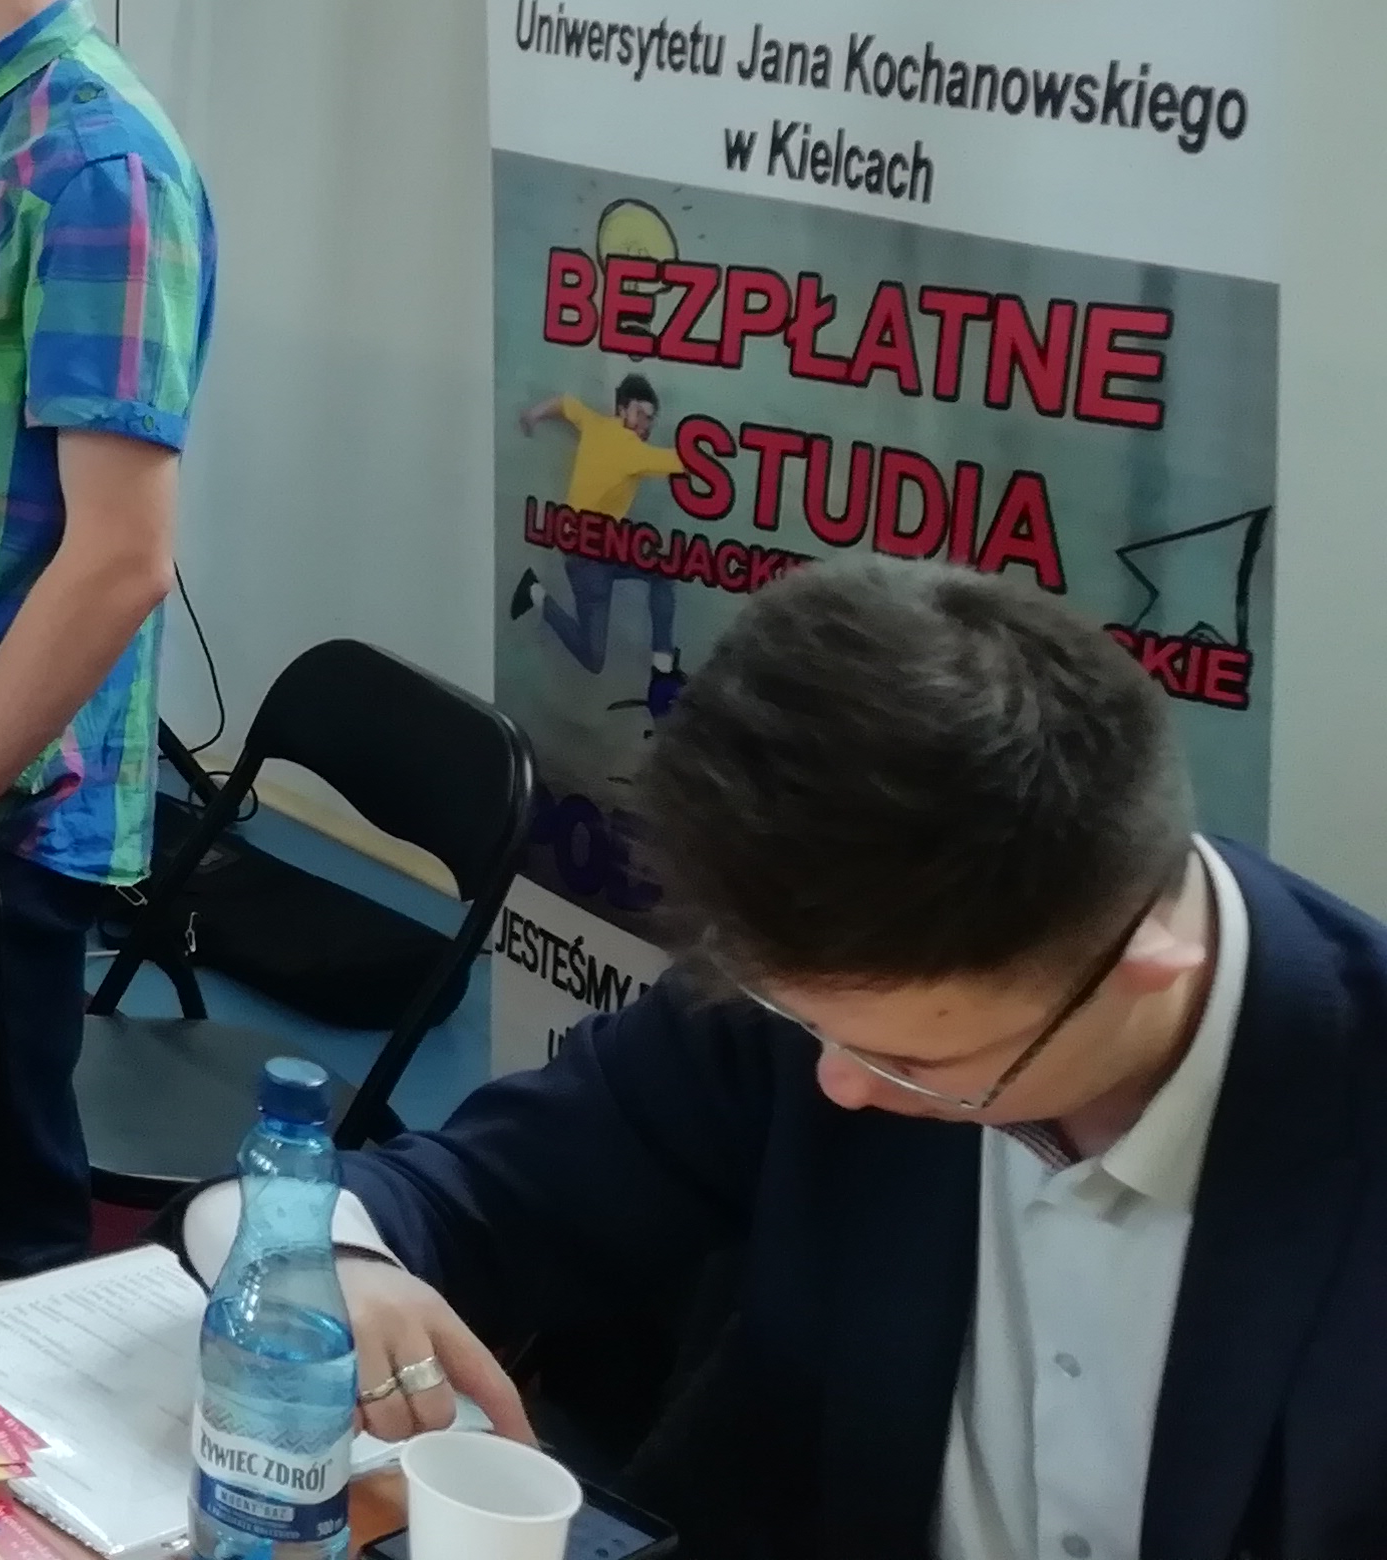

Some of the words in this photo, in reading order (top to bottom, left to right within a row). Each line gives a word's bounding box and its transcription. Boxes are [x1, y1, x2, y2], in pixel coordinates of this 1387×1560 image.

[737, 25, 831, 91] Jana
[844, 32, 1250, 155] Kochanowskiego
[724, 128, 756, 172] w
[768, 121, 936, 204] Kielcach
[543, 248, 1174, 429] BEZPŁATNE
[669, 416, 1067, 595] STUDIA
[495, 906, 633, 1013] JESTEŚMY
[262, 1455, 326, 1493] ZDRÓJ
